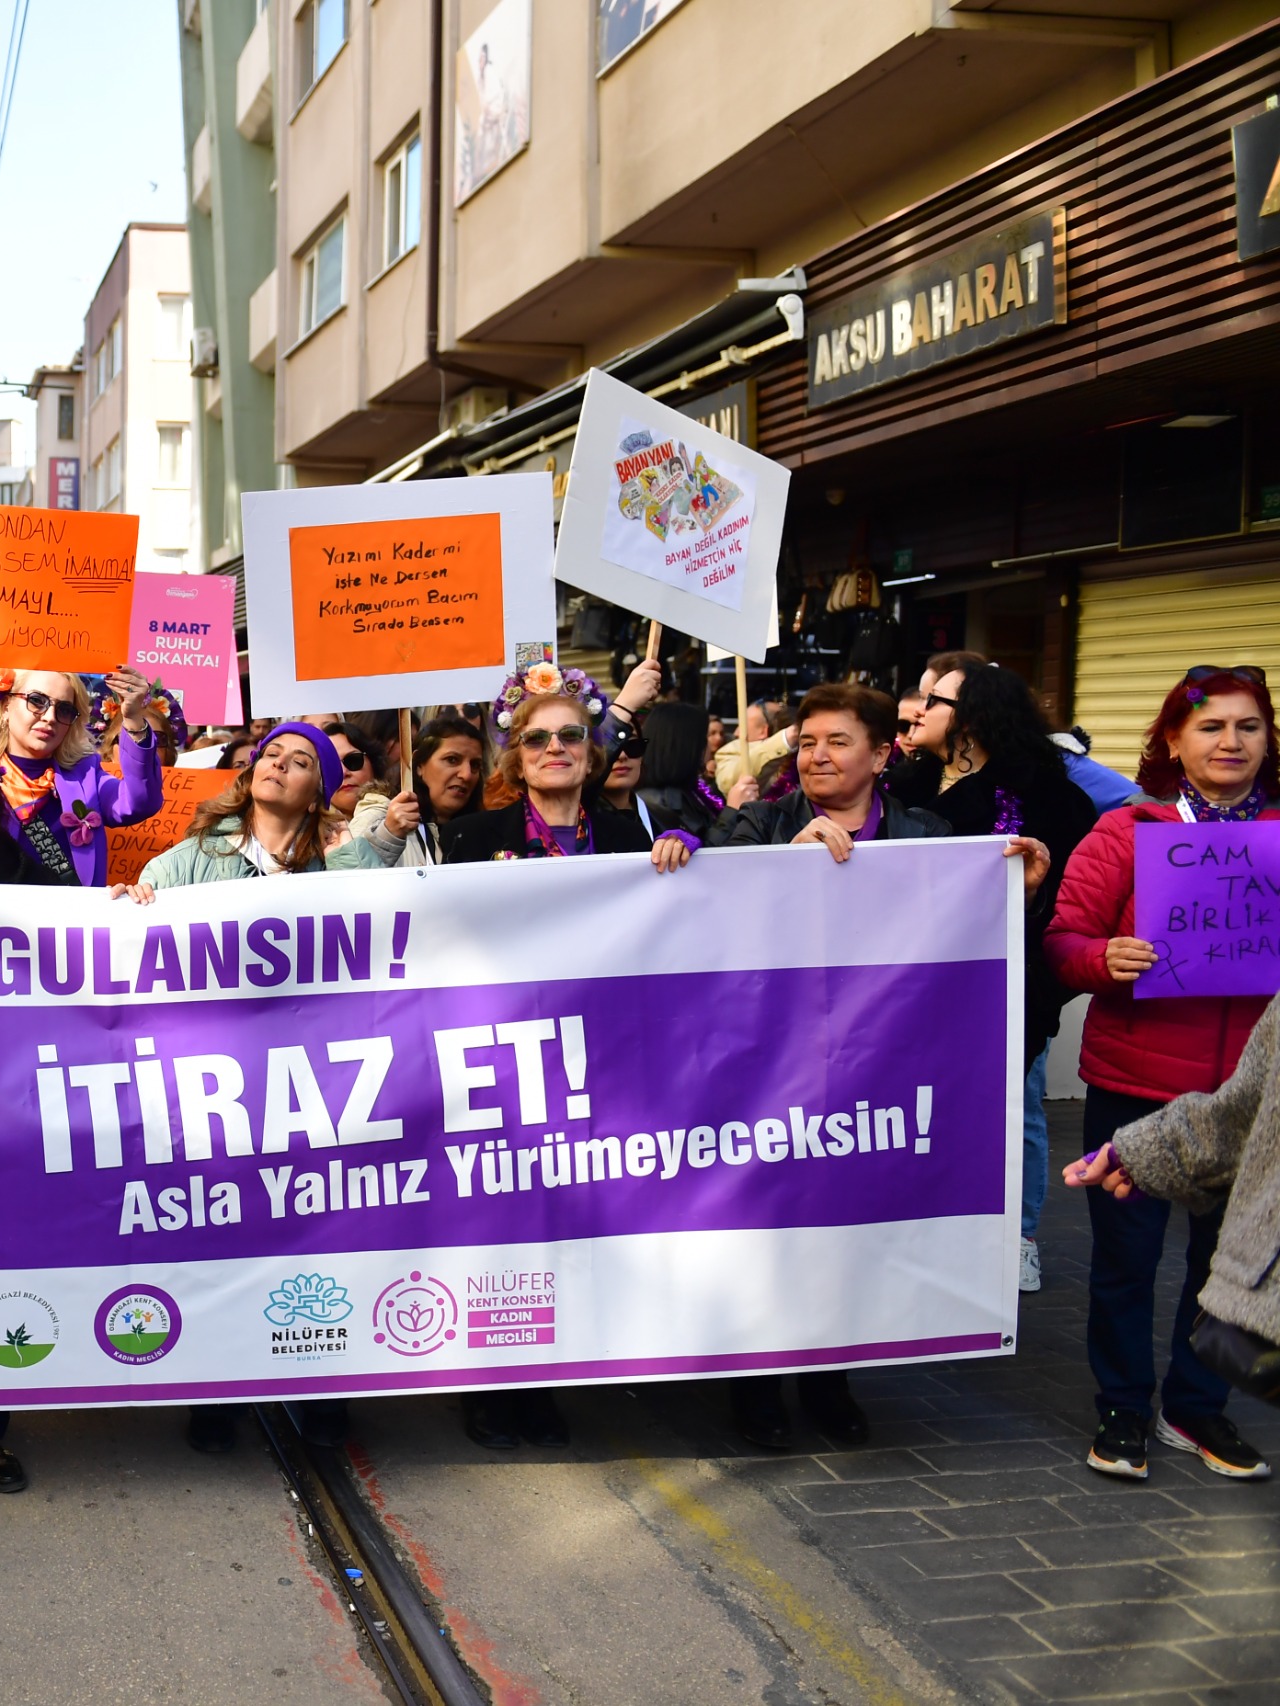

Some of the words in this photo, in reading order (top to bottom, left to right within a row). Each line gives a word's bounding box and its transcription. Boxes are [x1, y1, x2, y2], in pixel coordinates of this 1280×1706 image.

[813, 309, 886, 386] AKSU
[891, 241, 1045, 356] BAHARAT
[616, 450, 651, 485] BAYAN
[649, 441, 675, 469] YANI
[665, 546, 691, 566] BAYAN
[694, 532, 717, 553] DEĞİL
[717, 515, 750, 541] KADINIM
[728, 538, 743, 556] HİÇ
[63, 547, 135, 580] İNANMA!
[370, 573, 388, 587] Ne
[394, 568, 448, 585] Dersen
[702, 563, 736, 588] DEĞİLİM
[148, 620, 159, 633] 8
[162, 621, 211, 635] MART
[155, 636, 202, 651] RUHU
[136, 651, 220, 668] SOKAKTA!
[1167, 842, 1253, 868] CAM
[1167, 901, 1280, 932] BİRLİK
[35, 1036, 404, 1174] İTİRAZ
[433, 1015, 592, 1134] ET!
[119, 1175, 242, 1235] Asla
[259, 1158, 431, 1219] Yalnız
[444, 1085, 933, 1198] Yürümeyeceksin!
[467, 1270, 556, 1293] NİLÜFER
[467, 1296, 499, 1308] KENT
[501, 1293, 556, 1306] KONSEYİ
[22, 1291, 61, 1324] BELEDİYESİ
[53, 1324, 61, 1340] 1987
[108, 1297, 133, 1332] OSMANGAZİ
[134, 1297, 153, 1305] KENT
[152, 1302, 169, 1330] KONSEYİ
[490, 1311, 533, 1324] KADIN
[271, 1327, 348, 1342] NİLÜFER
[485, 1330, 538, 1345] MECLİSİ
[113, 1350, 135, 1363] KADIN
[136, 1347, 165, 1363] MECLİSİ
[271, 1341, 347, 1355] BELEDİYESİ
